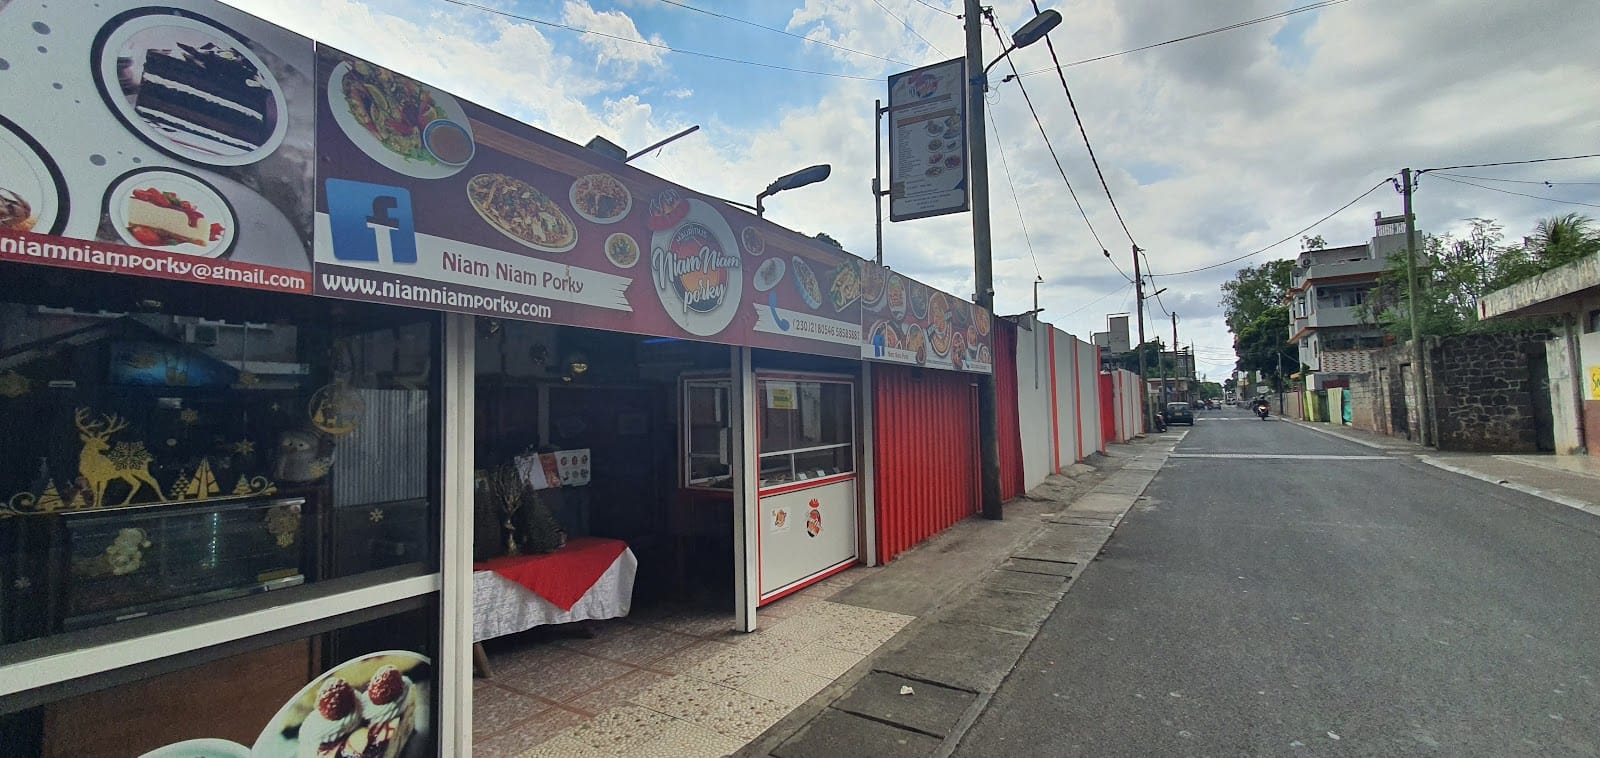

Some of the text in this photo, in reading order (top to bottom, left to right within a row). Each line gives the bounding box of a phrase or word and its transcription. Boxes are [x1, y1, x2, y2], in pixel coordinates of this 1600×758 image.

[1, 236, 306, 291] niamniamporky@gmail.com
[442, 251, 584, 294] Niam Niam Porky
[652, 246, 741, 290] Niam Niam
[322, 273, 552, 318] www.niamniamporky.com
[683, 279, 726, 313] porky
